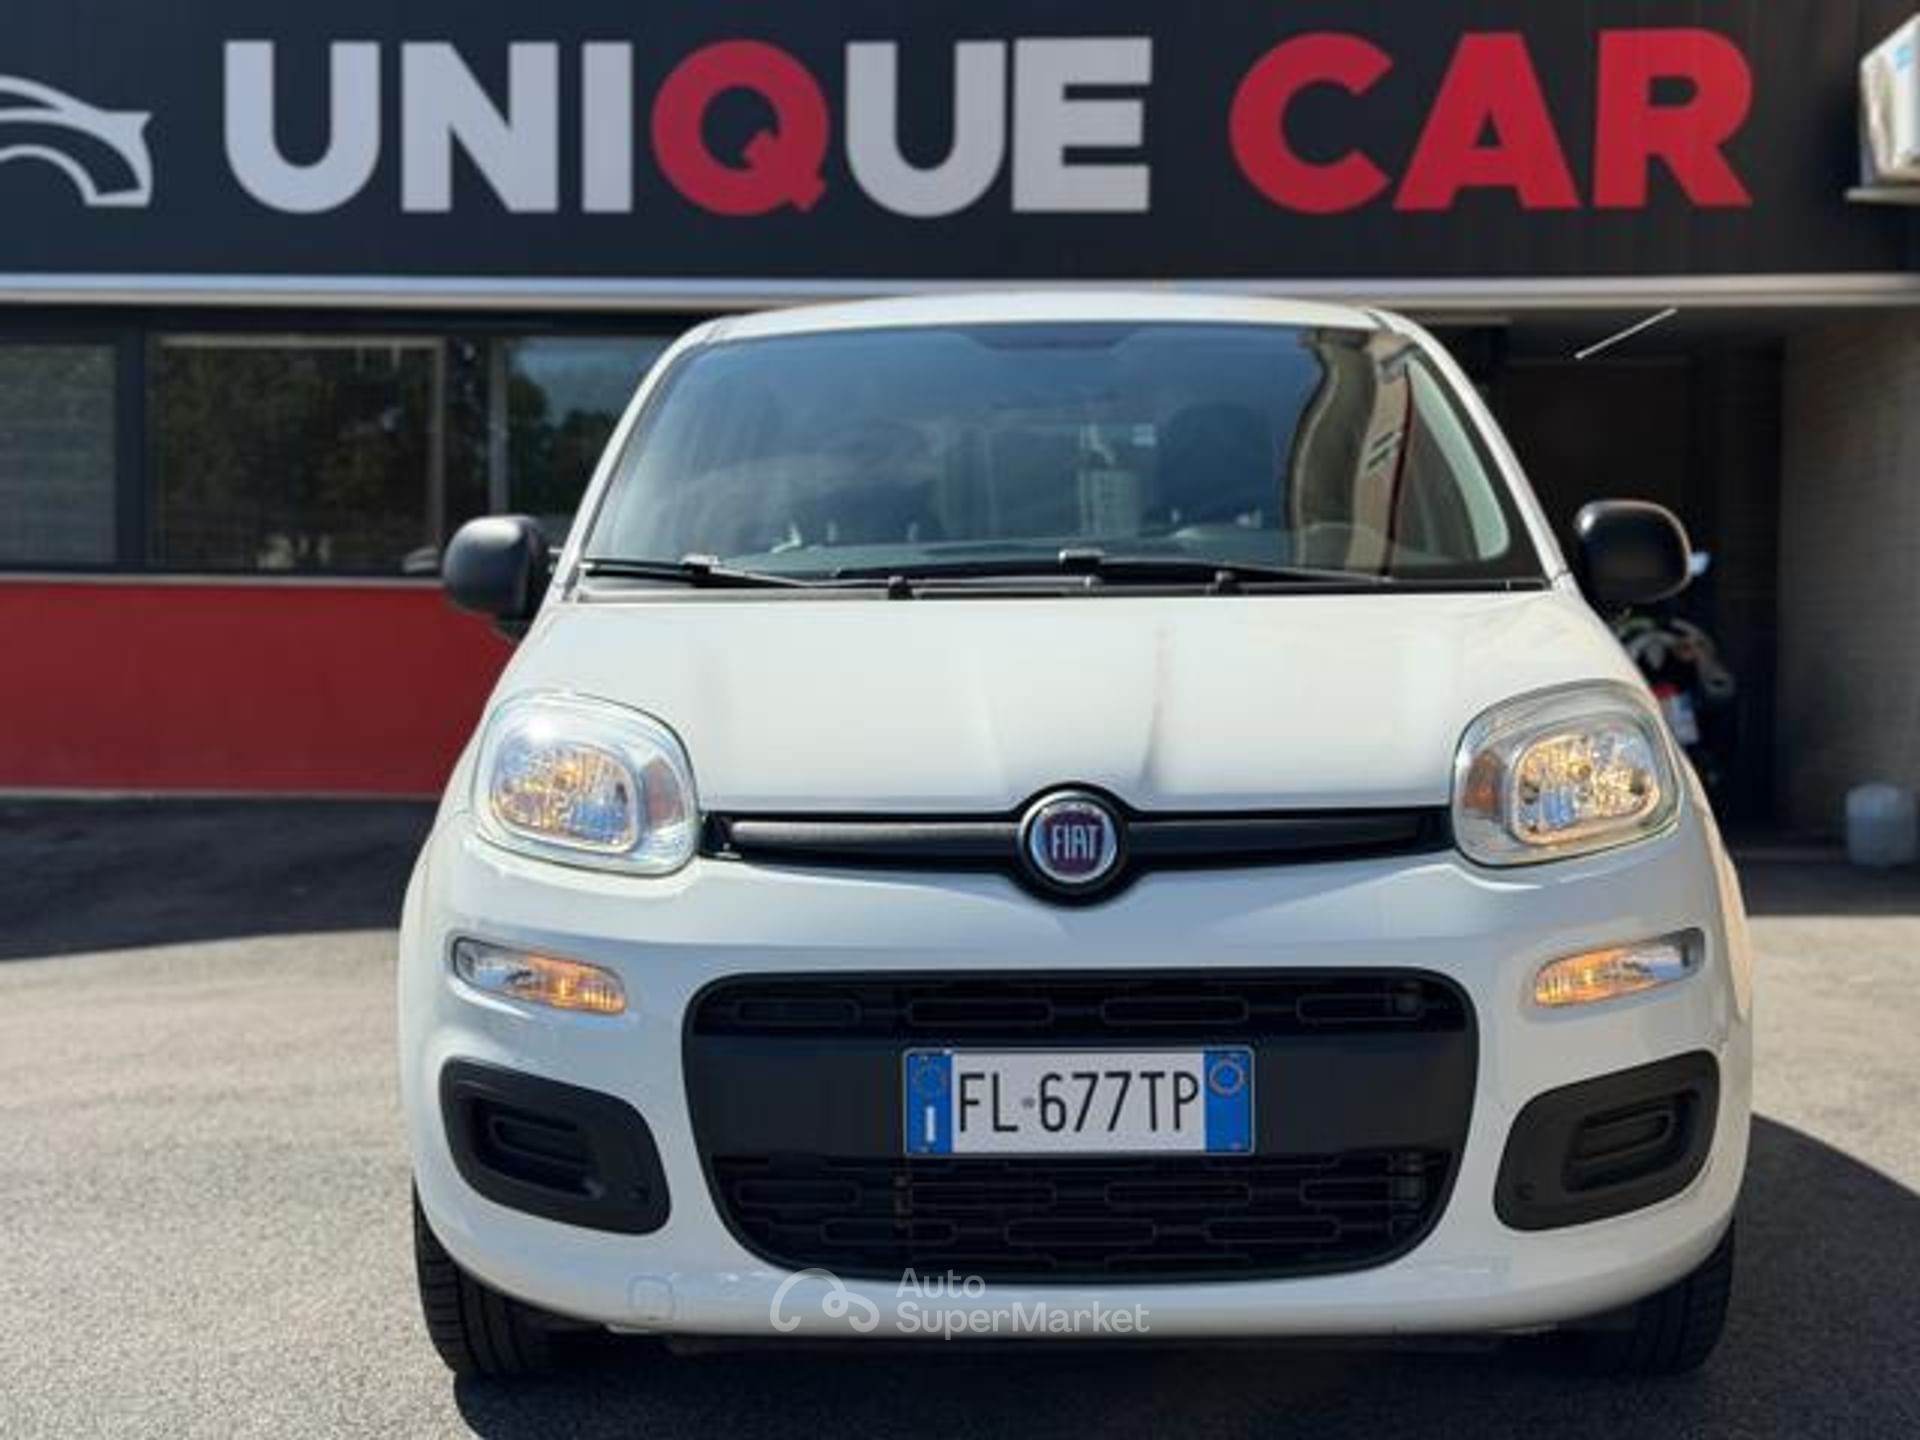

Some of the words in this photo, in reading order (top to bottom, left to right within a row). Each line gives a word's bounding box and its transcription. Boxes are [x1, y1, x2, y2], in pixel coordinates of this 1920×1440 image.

[224, 37, 1153, 217] UNIQUE
[1228, 28, 1754, 214] CAR
[1052, 822, 1100, 861] FIAT
